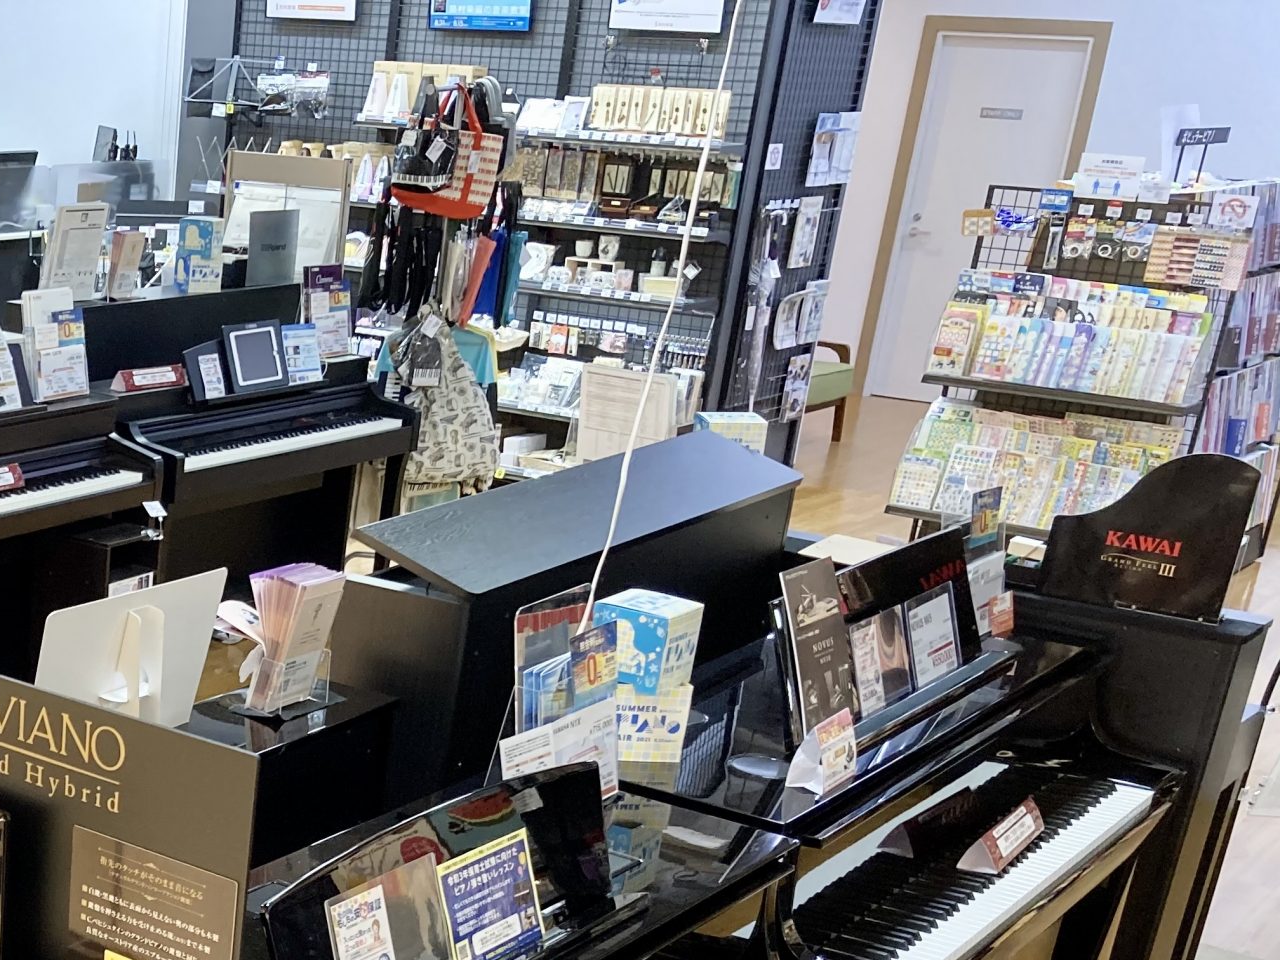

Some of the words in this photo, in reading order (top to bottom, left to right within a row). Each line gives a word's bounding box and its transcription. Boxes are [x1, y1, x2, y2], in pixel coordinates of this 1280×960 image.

[1105, 529, 1183, 558] KAWAI
[1100, 553, 1132, 567] GRAND
[1135, 560, 1158, 571] FEEL
[1158, 562, 1177, 578] III
[812, 637, 834, 653] NOVUS
[615, 704, 658, 713] SUMMER
[24, 760, 121, 814] Hybrid
[100, 855, 204, 901] 指先のタッチがそのまま音になる
[453, 861, 515, 896] ピアノ弾き歌いレッスン
